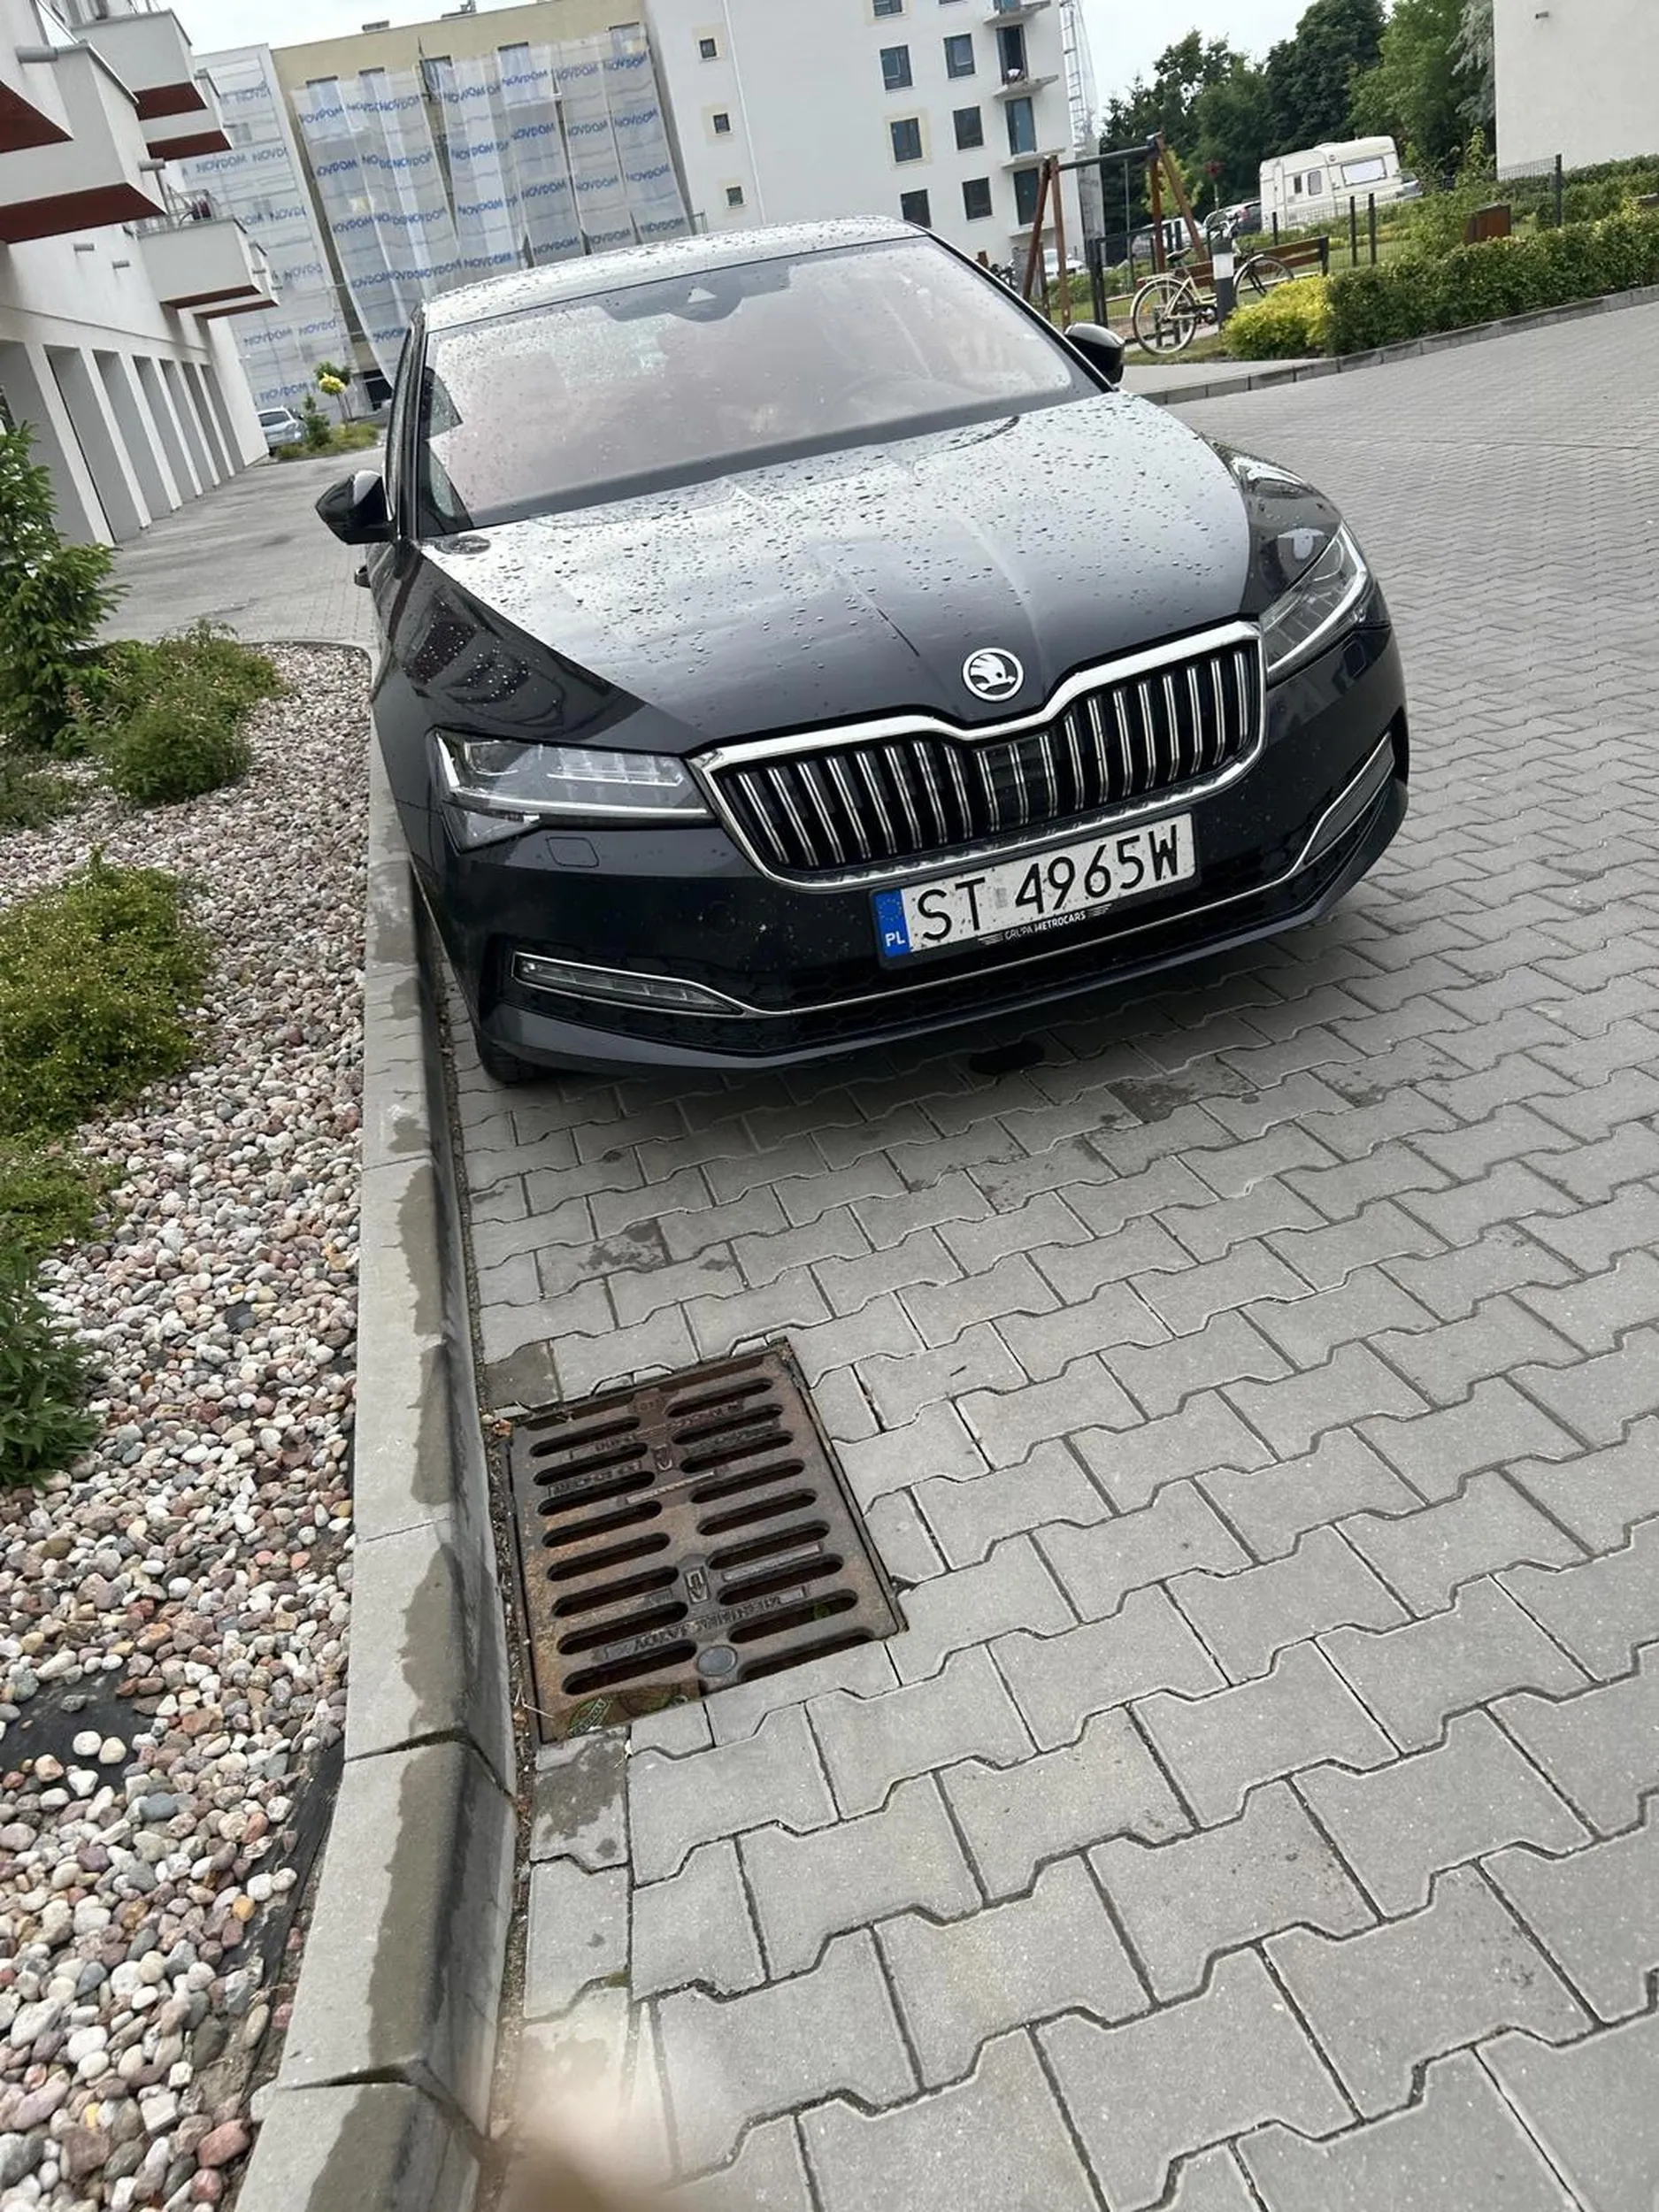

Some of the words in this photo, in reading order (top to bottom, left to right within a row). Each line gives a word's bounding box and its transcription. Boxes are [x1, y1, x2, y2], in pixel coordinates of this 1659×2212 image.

[917, 877, 986, 941] ST
[1015, 824, 1179, 915] 4965W
[1033, 910, 1087, 933] METROCARS
[885, 932, 906, 947] PL
